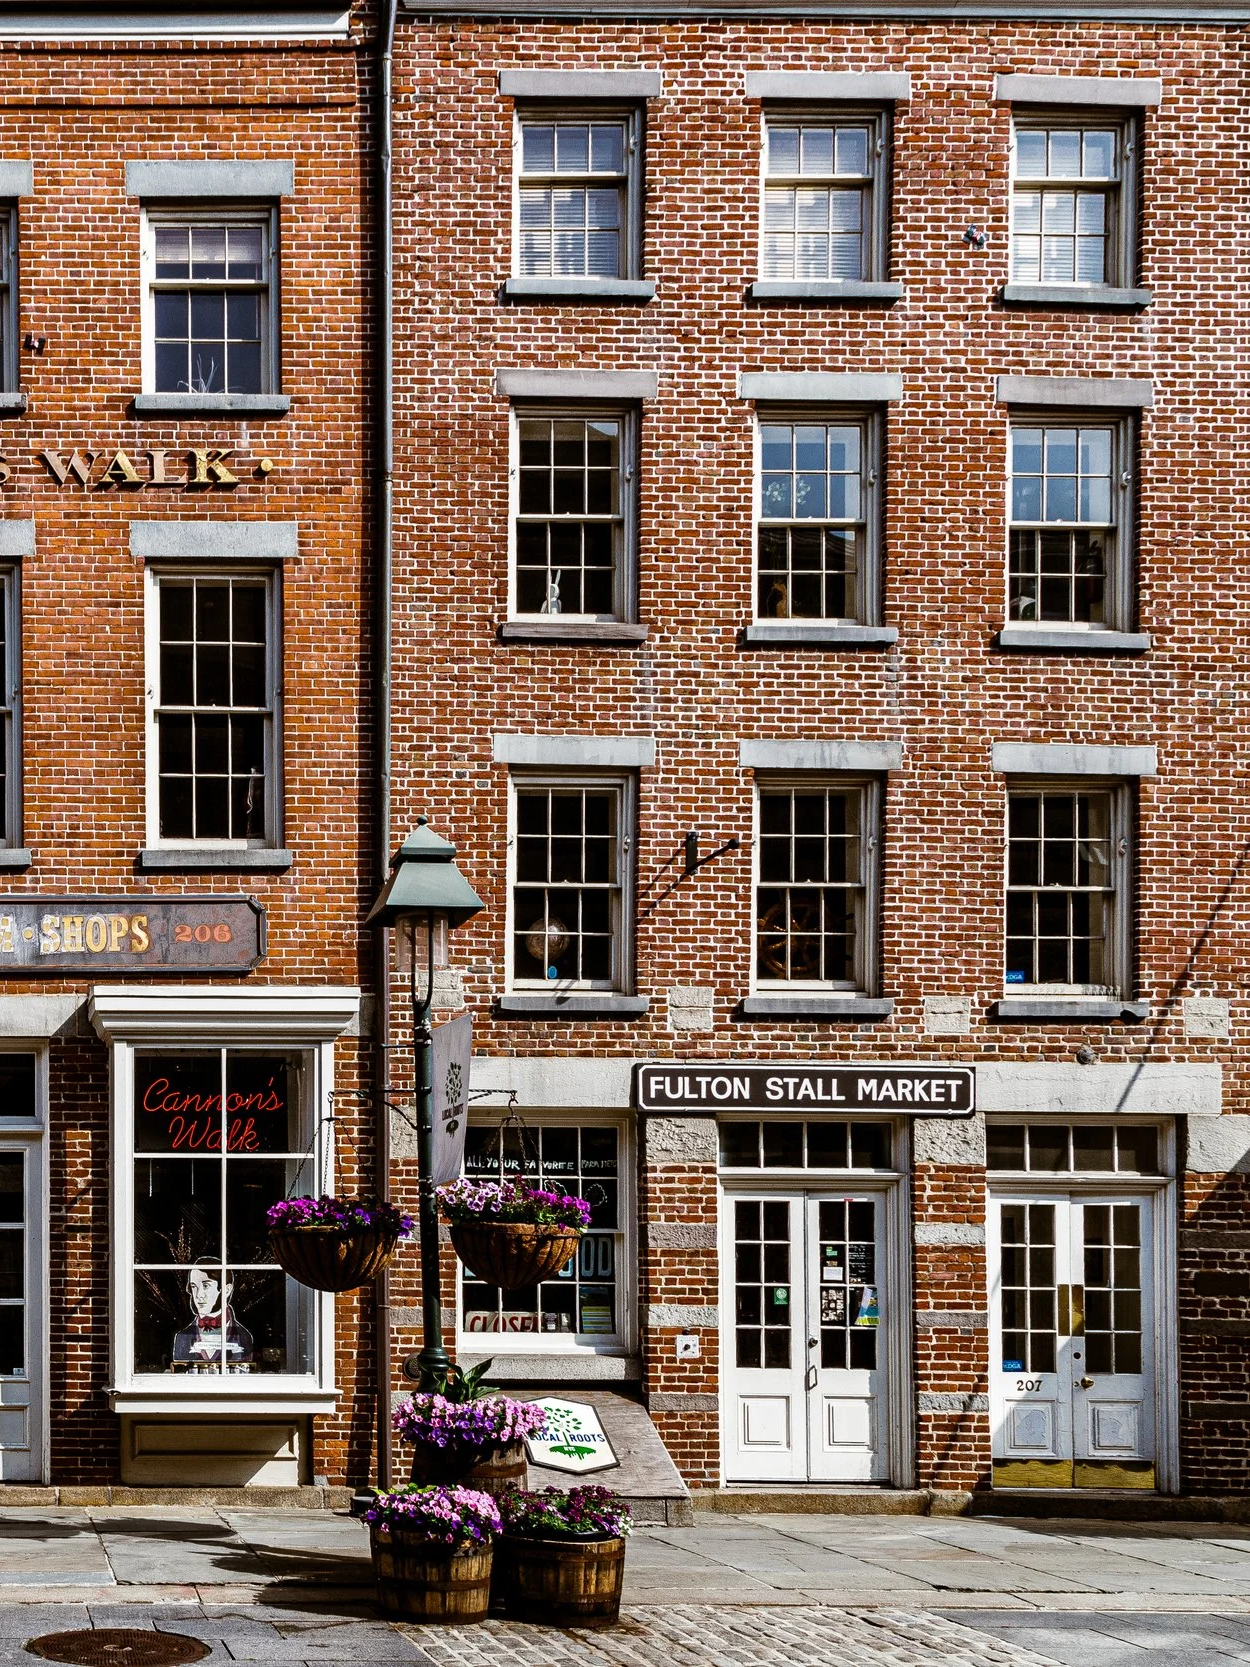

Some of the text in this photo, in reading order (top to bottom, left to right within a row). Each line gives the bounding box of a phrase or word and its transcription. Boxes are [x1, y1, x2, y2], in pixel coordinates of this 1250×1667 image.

[40, 449, 241, 485] WALK
[40, 914, 150, 954] SHOPS
[174, 924, 232, 943] 206
[143, 1076, 285, 1113] Cannon's
[650, 1076, 963, 1102] FULTON STALL MARKET
[168, 1115, 261, 1151] Walk
[1016, 1380, 1043, 1392] 207
[569, 1433, 606, 1443] ROOTS
